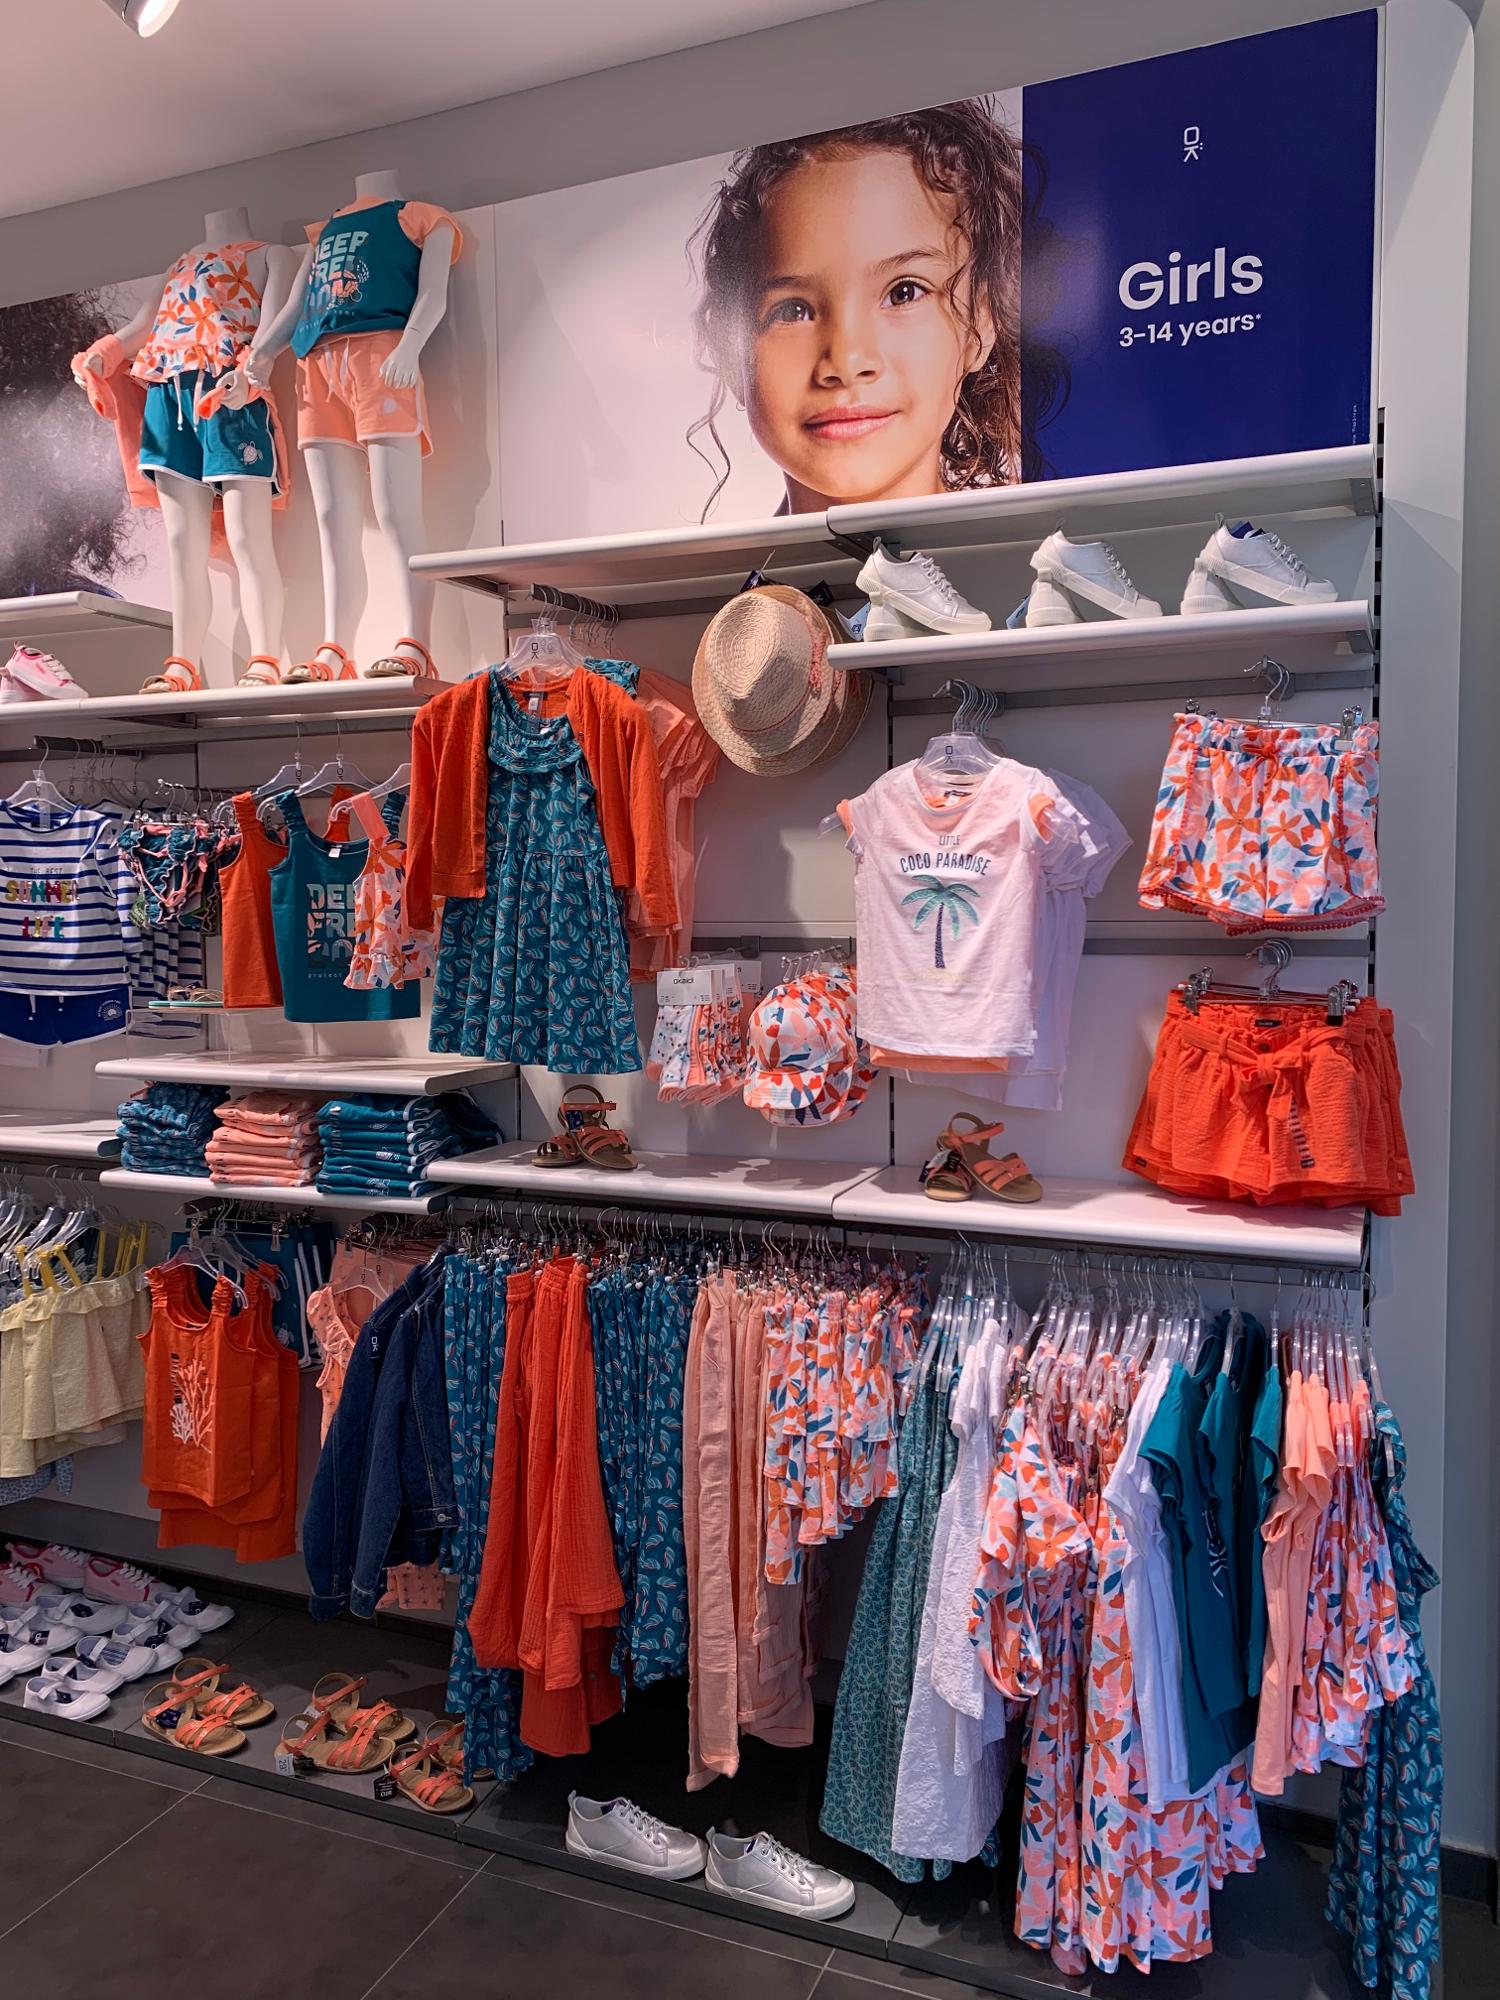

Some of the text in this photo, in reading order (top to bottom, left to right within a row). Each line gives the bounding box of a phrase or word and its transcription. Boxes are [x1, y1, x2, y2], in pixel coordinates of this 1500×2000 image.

[315, 231, 369, 264] EEP
[1118, 247, 1263, 311] Girls
[1119, 320, 1173, 348] 3-14
[939, 834, 960, 846] LITTLE
[900, 852, 991, 876] COCO PARADISE
[5, 880, 80, 903] SUMMER
[307, 883, 356, 910] DEE
[22, 916, 65, 939] LIFE
[307, 912, 357, 938] FRE
